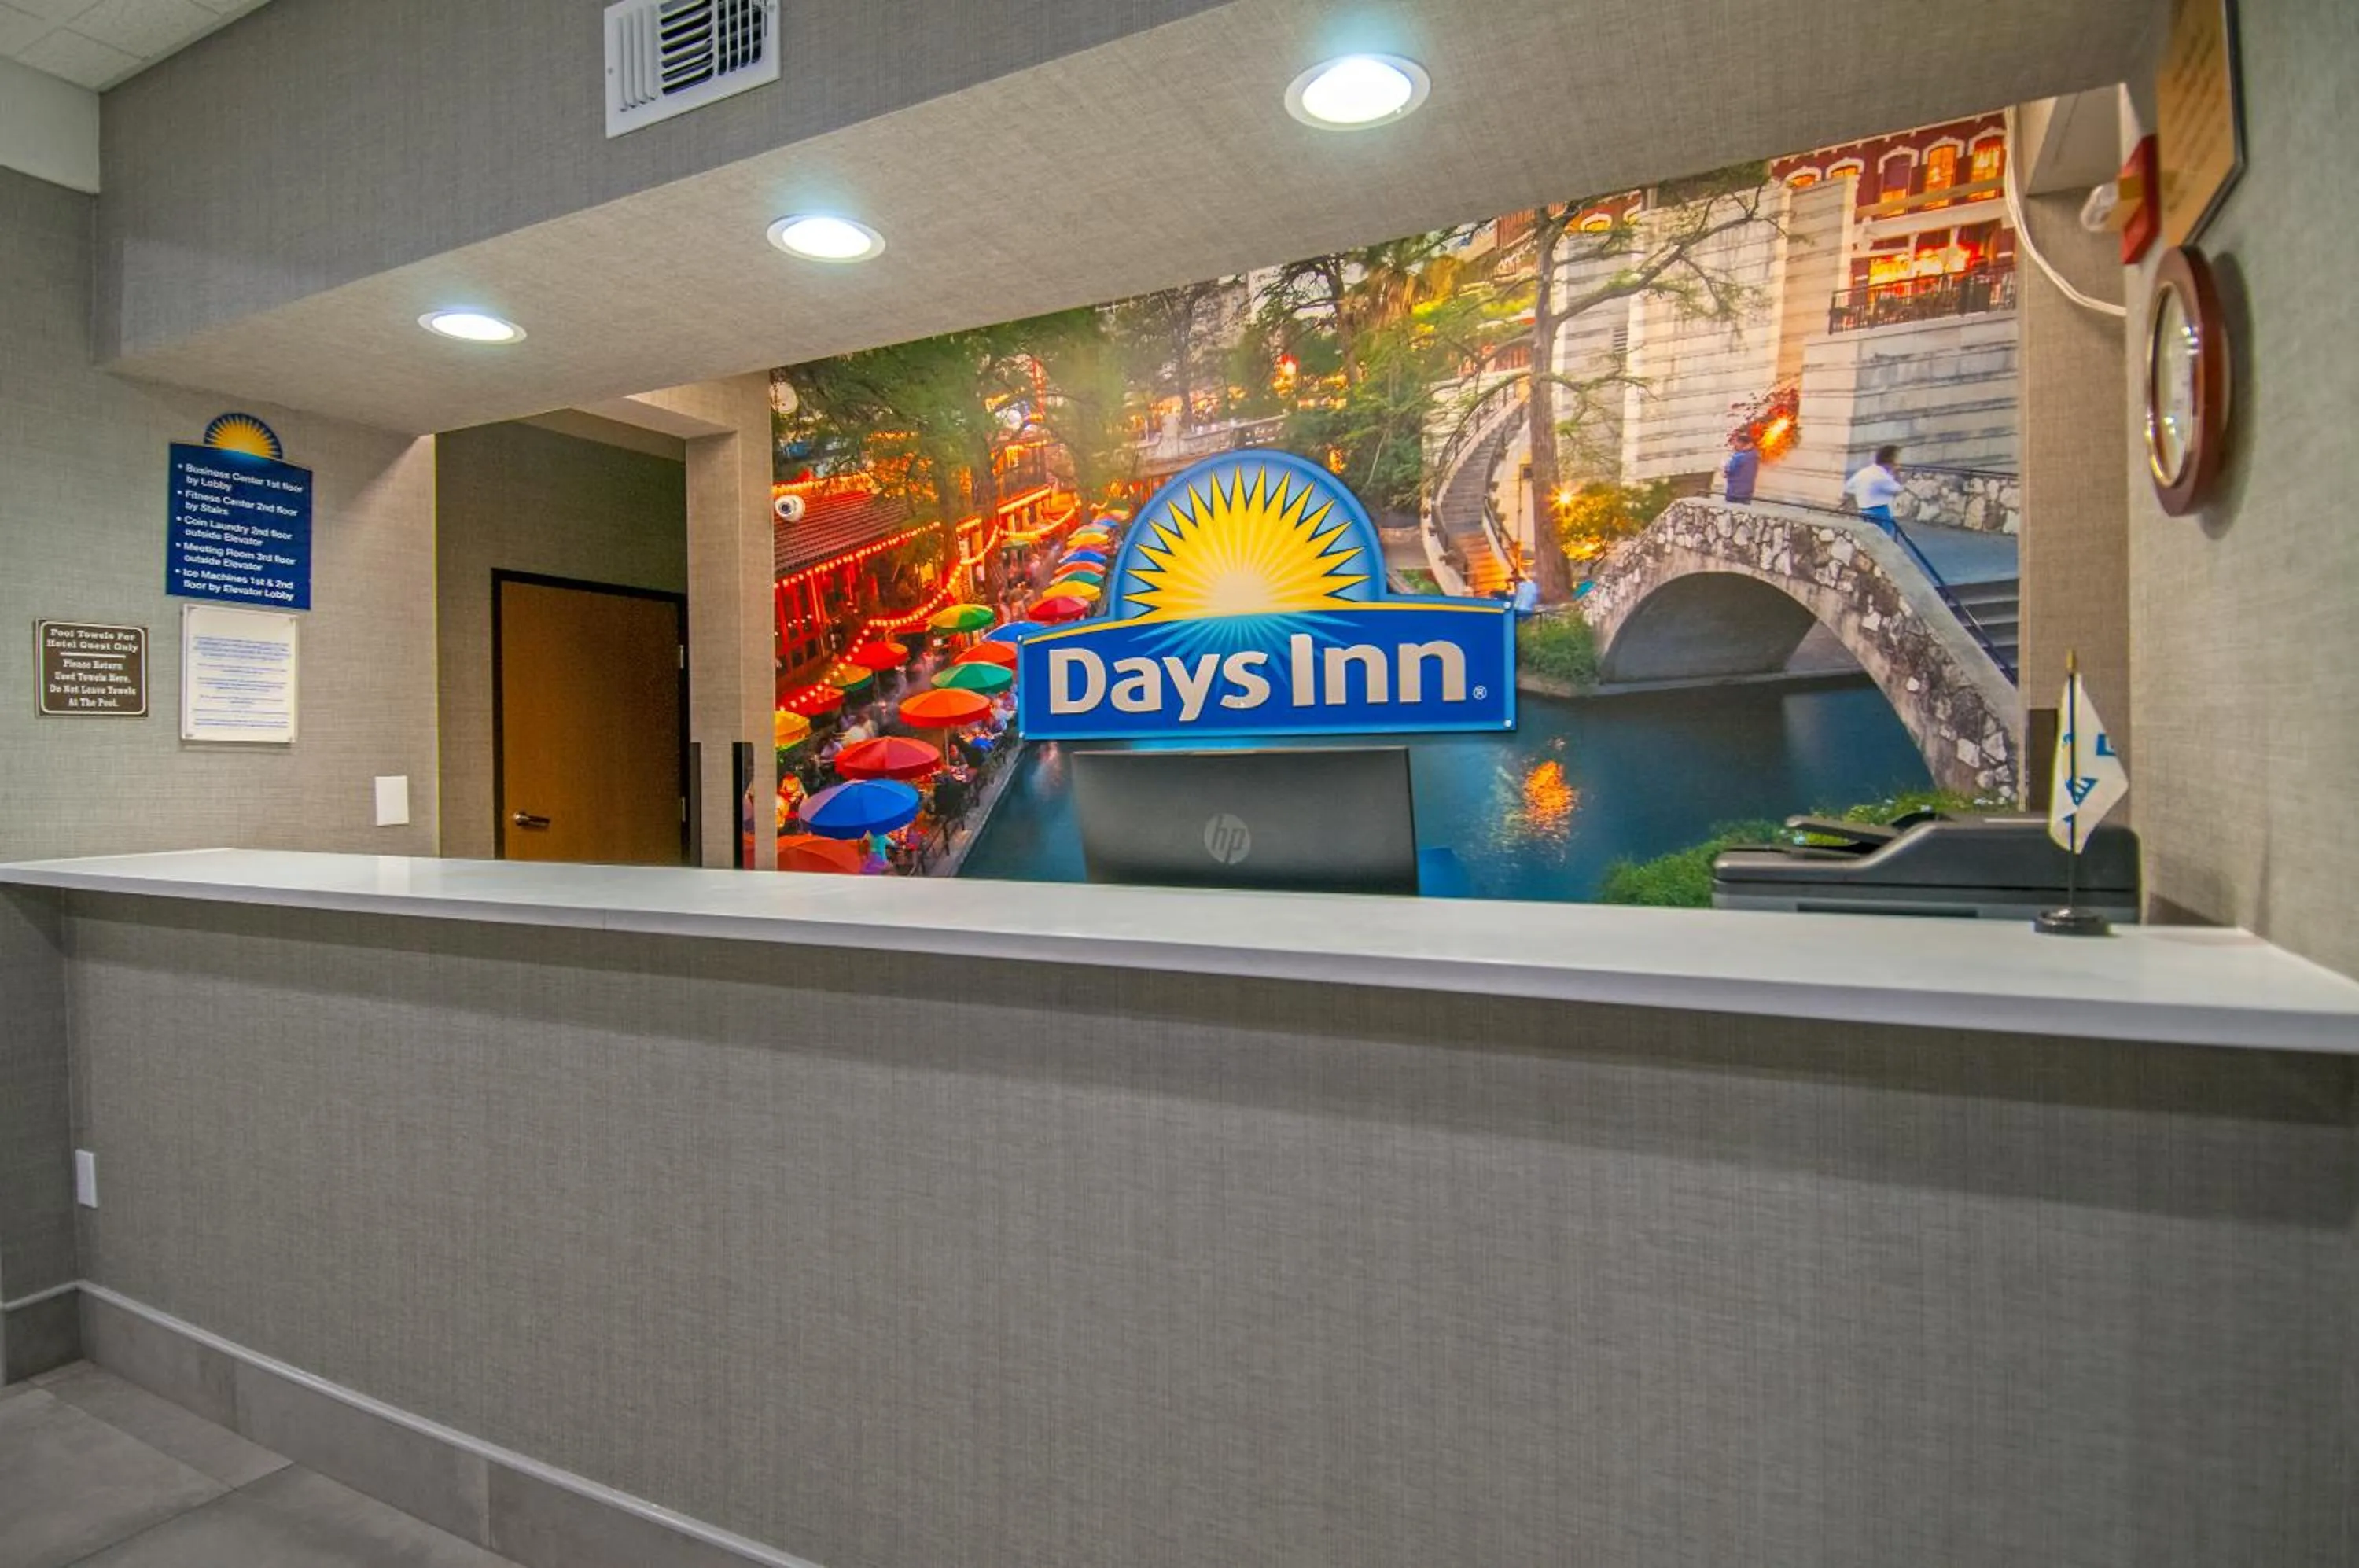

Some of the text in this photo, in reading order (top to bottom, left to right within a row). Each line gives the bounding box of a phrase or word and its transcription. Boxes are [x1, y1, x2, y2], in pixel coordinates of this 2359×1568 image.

[186, 463, 303, 492] Business Center 1st floor
[186, 476, 232, 491] by Lobby
[185, 490, 298, 517] Fitness Center 2nd floor
[185, 502, 229, 515] by Stairs
[184, 516, 293, 539] Coin Laundry 2nd floor
[185, 529, 263, 546] outside Elevator
[183, 543, 296, 565] Meeting Room 3rd floor
[184, 555, 263, 571] outside Elevator
[183, 569, 199, 578] Ice
[201, 571, 248, 583] Machines
[250, 577, 264, 586] 1st
[276, 580, 293, 589] 2nd
[183, 580, 294, 601] floor by Elevator Lobby
[77, 631, 114, 639] Towels
[47, 639, 138, 653] Hotel Guest Only
[64, 659, 91, 668] Please
[1048, 646, 1272, 722] Days
[1290, 633, 1467, 707] Inn
[1209, 814, 1248, 865] hp
